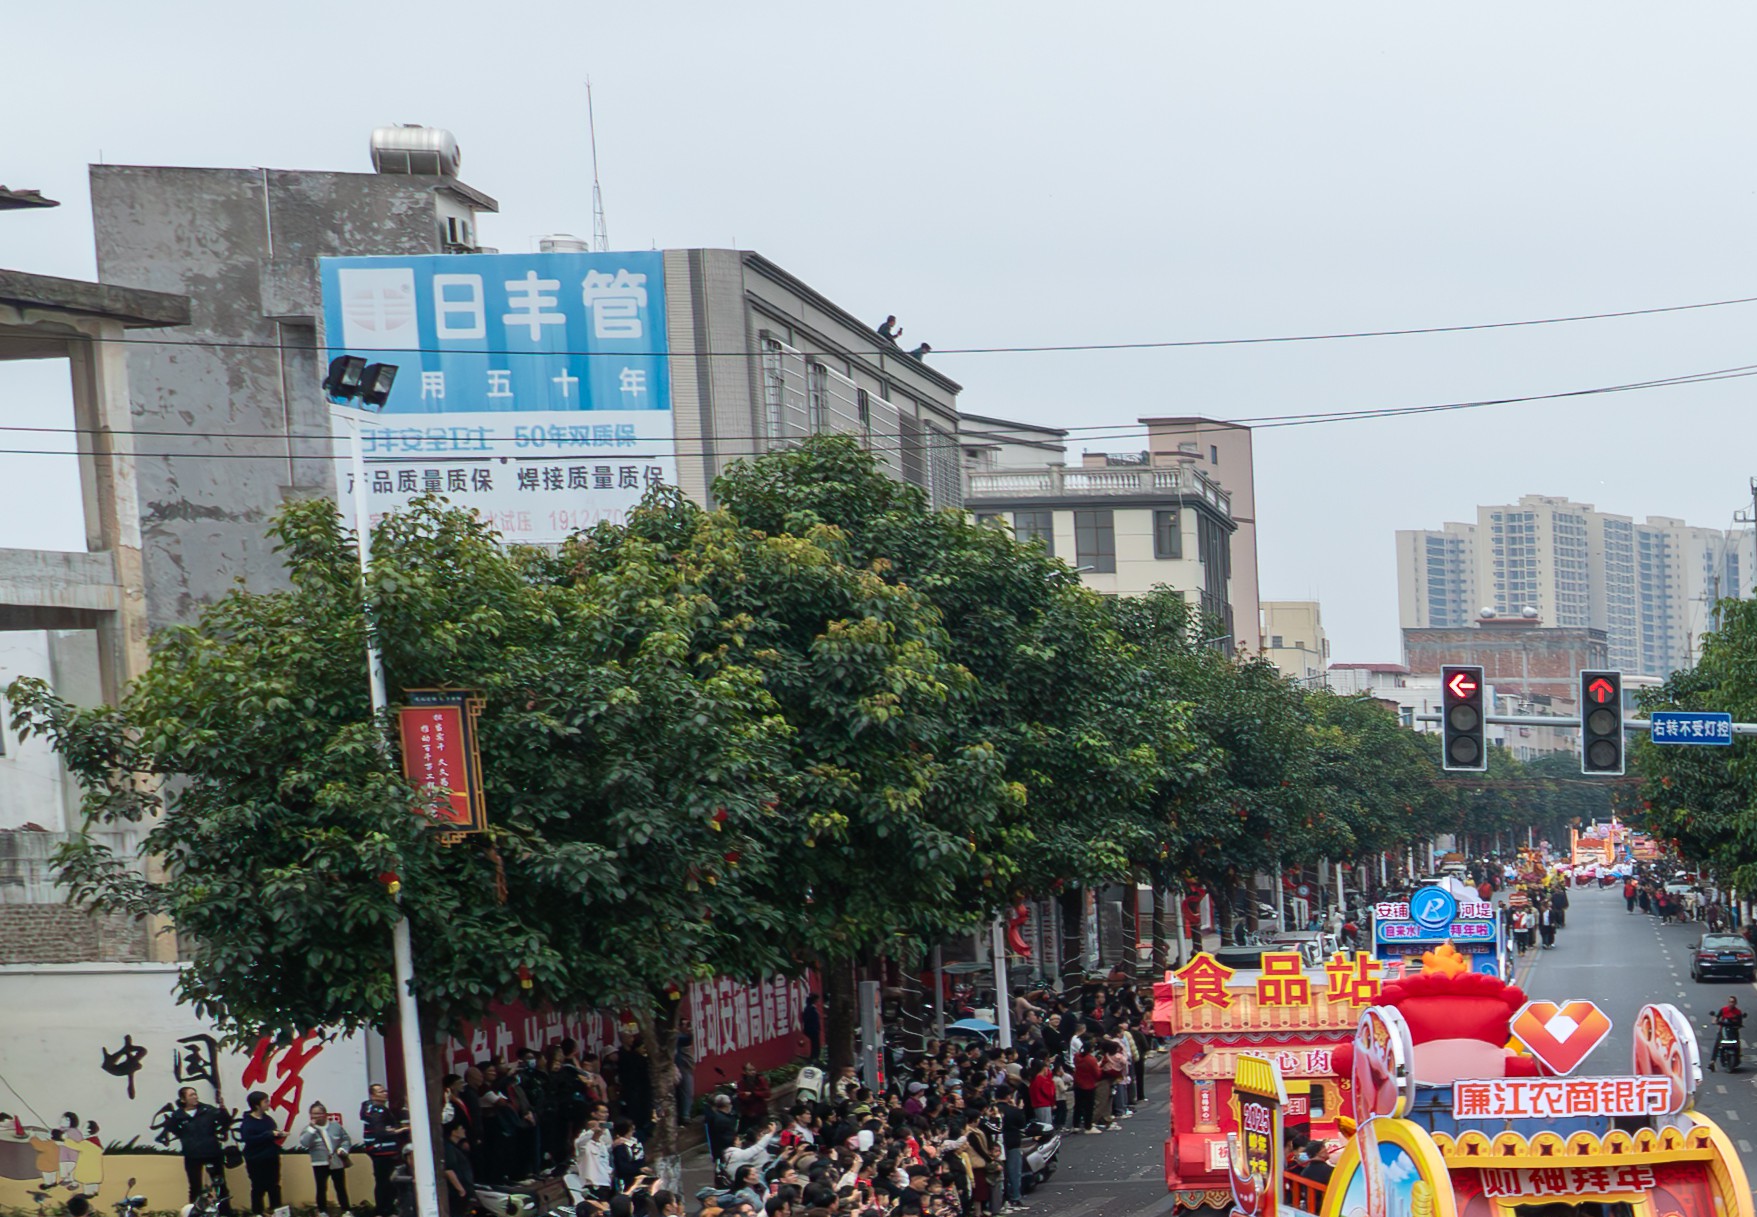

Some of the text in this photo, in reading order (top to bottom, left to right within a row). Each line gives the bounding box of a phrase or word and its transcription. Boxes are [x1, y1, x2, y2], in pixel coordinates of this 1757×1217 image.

[433, 269, 648, 341] 日丰管
[514, 424, 637, 448] 50年双质保
[346, 465, 665, 494] 产品质量质保 焊接质量质保
[1654, 718, 1730, 738] 右转不受灯控
[1377, 902, 1493, 919] 安铺 河堤
[1385, 923, 1489, 938] 自来水 拜年啦
[1176, 952, 1382, 1010] 食品站
[1456, 1081, 1669, 1116] 廉江农商银行
[1244, 1103, 1270, 1134] 2025
[1480, 1167, 1655, 1197] 财神拜年
